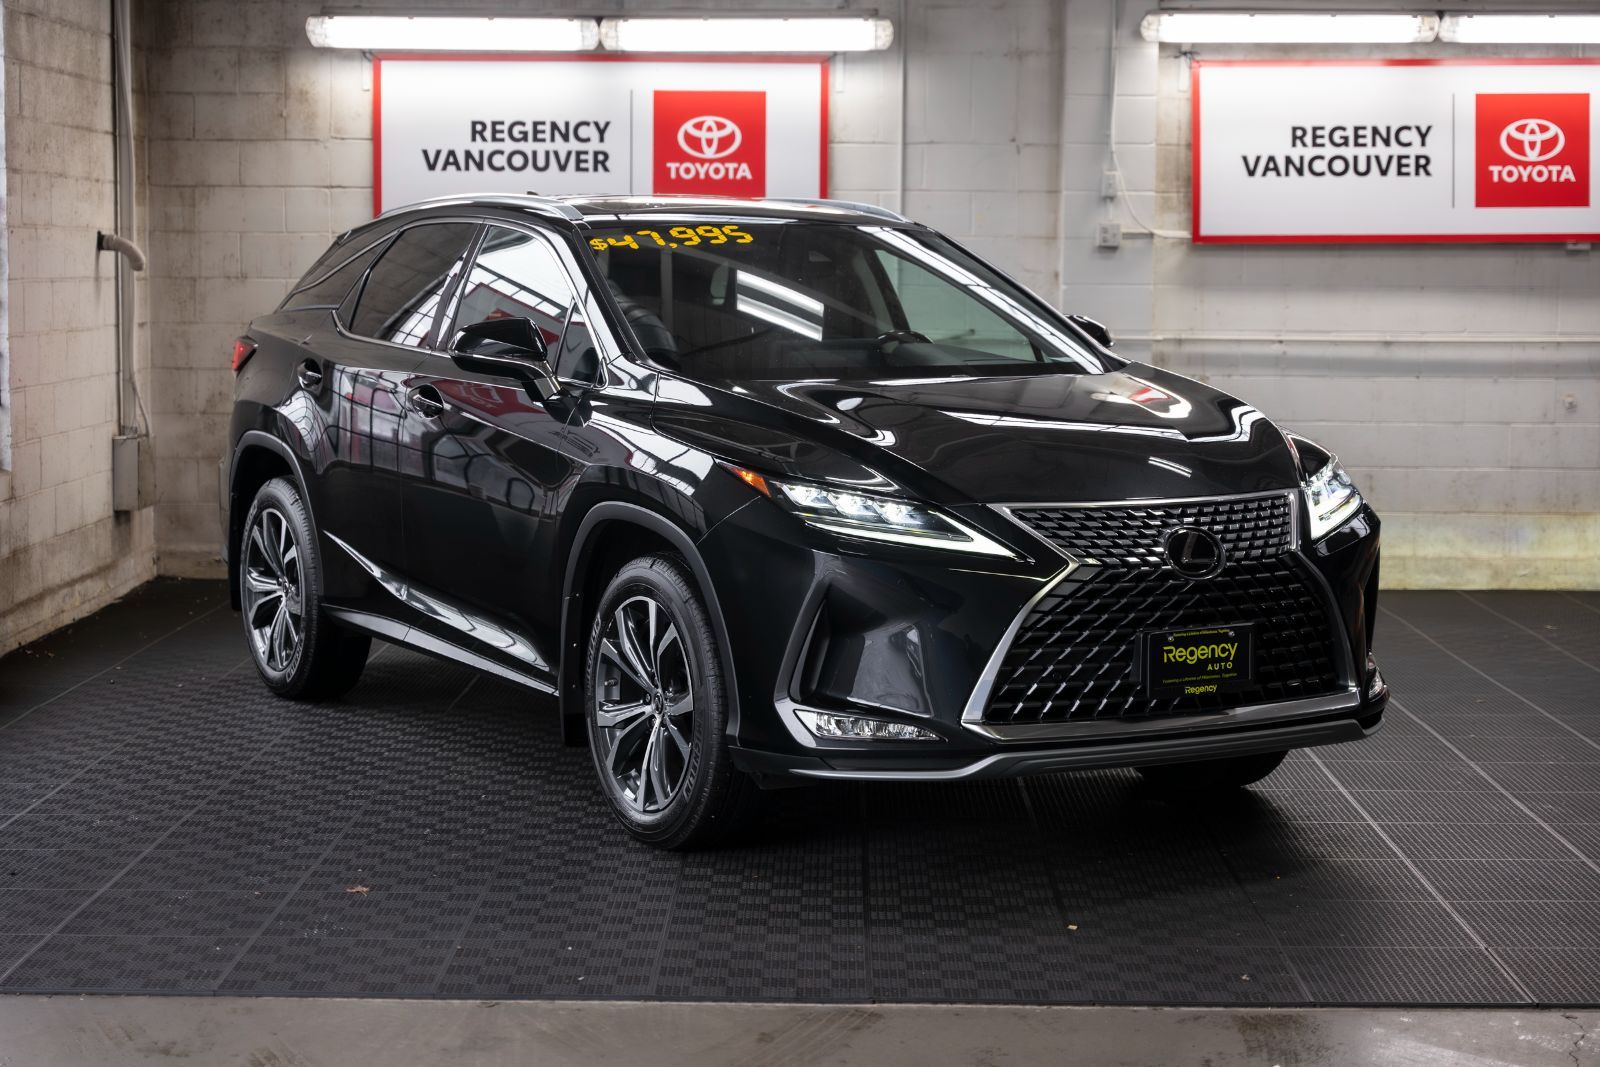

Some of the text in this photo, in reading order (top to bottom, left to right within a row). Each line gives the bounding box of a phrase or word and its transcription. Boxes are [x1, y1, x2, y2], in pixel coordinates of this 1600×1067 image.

[470, 120, 611, 143] REGENCY
[1291, 125, 1433, 148] REGENCY
[422, 149, 611, 173] VANCOUVER
[666, 162, 753, 180] TOYOTA
[1242, 154, 1432, 177] VANCOUVER
[1489, 165, 1576, 183] TOYOTA
[1163, 642, 1238, 664] Regency
[1207, 662, 1233, 671] AUTO
[1184, 684, 1218, 695] Regency
